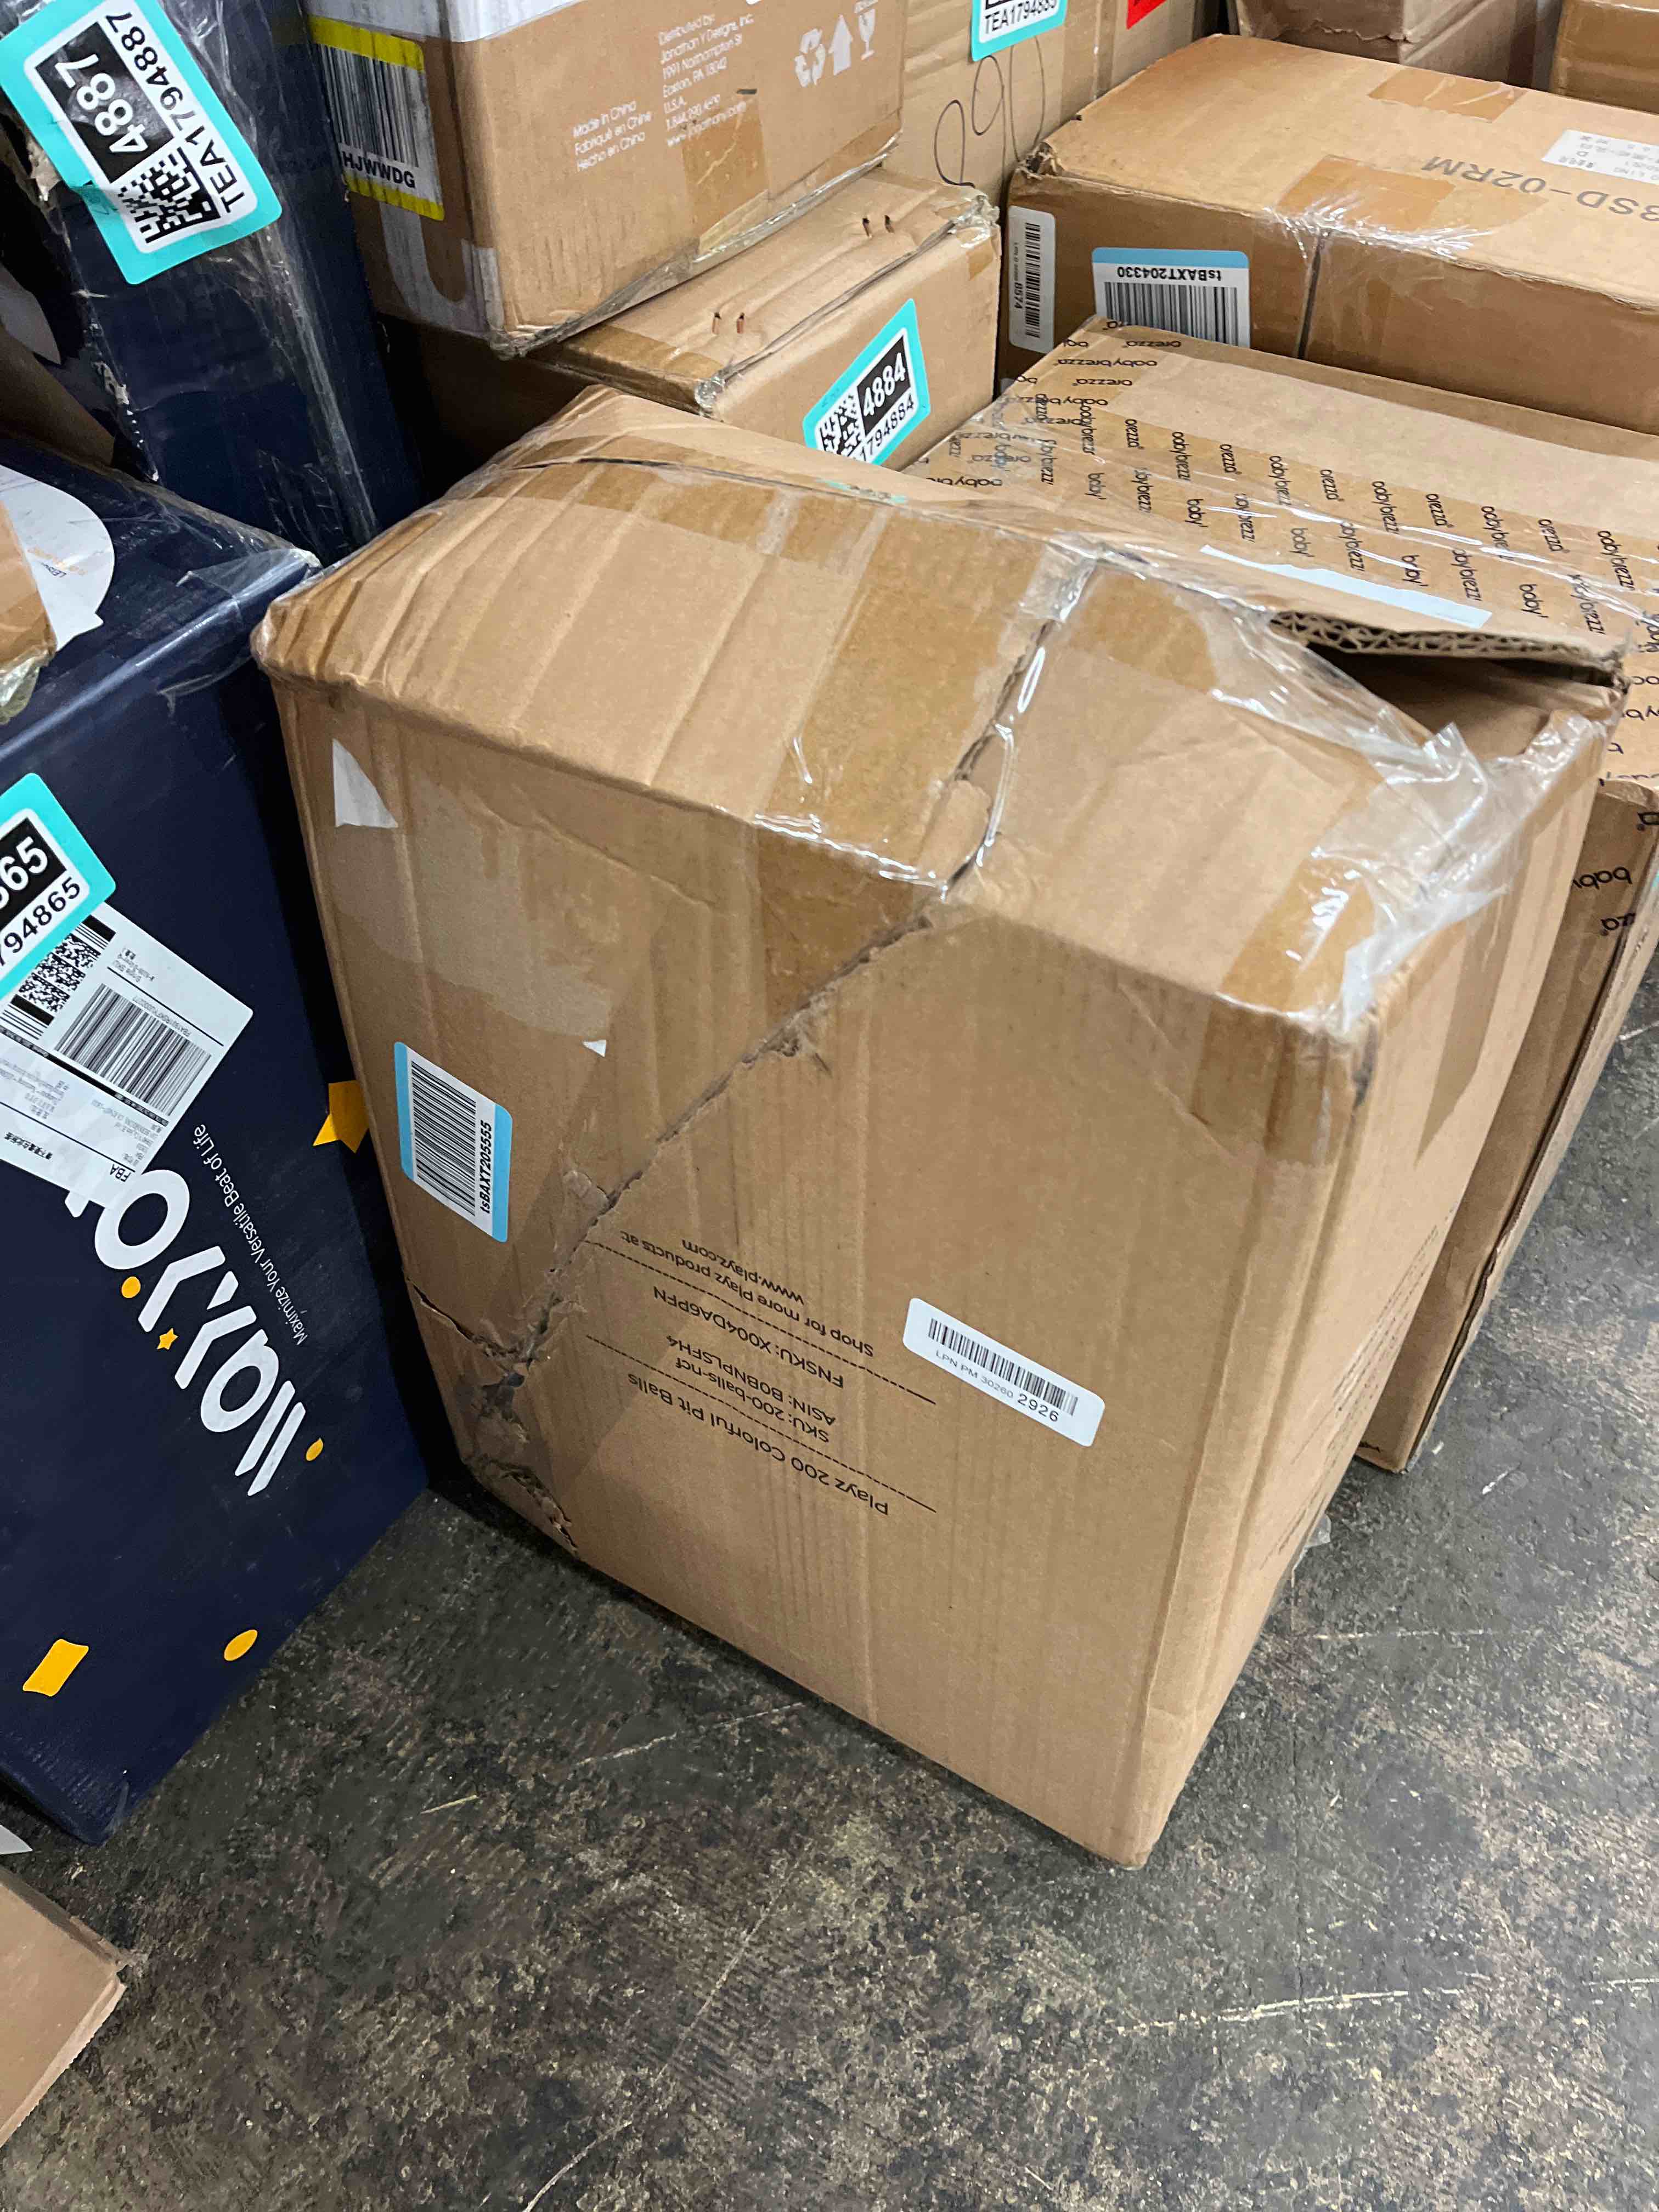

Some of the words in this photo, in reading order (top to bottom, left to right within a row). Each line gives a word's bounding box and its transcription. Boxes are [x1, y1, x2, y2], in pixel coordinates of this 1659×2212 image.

[54, 54, 149, 153] 4887
[105, 12, 246, 214] TEA1794887
[1117, 267, 1222, 281] tsBAXT204330
[864, 352, 906, 416] 4884
[857, 393, 915, 461] 1794884
[0, 876, 80, 966] 94865
[193, 1124, 215, 1157] Life
[109, 1163, 132, 1183] FBA
[204, 1153, 222, 1170] of
[479, 1120, 492, 1214] tsBAXT205555
[215, 1168, 240, 1207] Beat
[233, 1203, 266, 1263] Versatile
[620, 1231, 640, 1246] at
[260, 1259, 280, 1293] Your
[642, 1240, 711, 1278] products
[681, 1239, 804, 1305] www.playz.com
[276, 1286, 308, 1345] Maximize
[757, 1295, 799, 1322] more
[804, 1317, 827, 1336] for
[830, 1329, 874, 1357] Shop
[775, 1344, 844, 1389] FNSKU:
[628, 1373, 674, 1407] Balls
[675, 1357, 785, 1422] 200-balls-ncf
[935, 1350, 958, 1368] LPN
[961, 1364, 979, 1379] PM
[1017, 1392, 1060, 1423] 2926
[678, 1396, 705, 1421] Pit
[788, 1395, 836, 1426] ASIN:
[710, 1412, 786, 1463] Colorful
[788, 1413, 830, 1443] SKU:
[791, 1456, 830, 1486] 200
[834, 1477, 889, 1516] Playz
